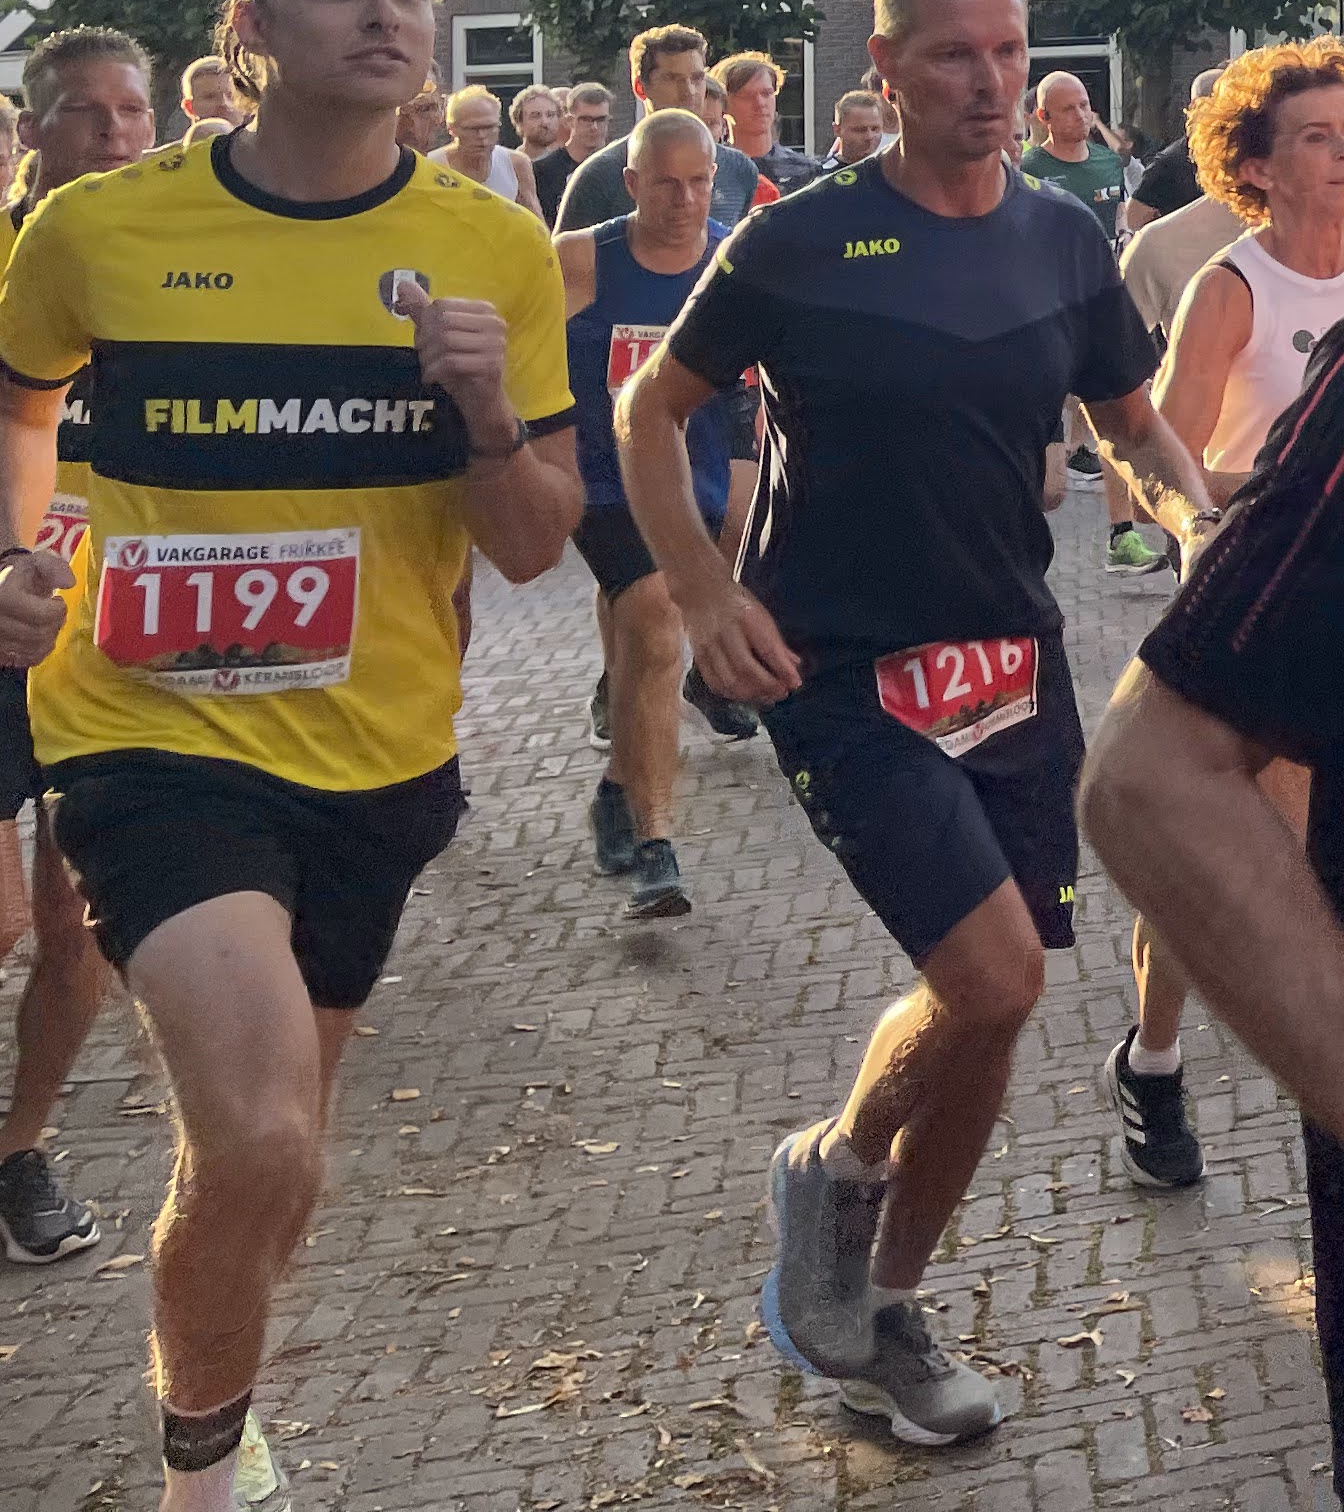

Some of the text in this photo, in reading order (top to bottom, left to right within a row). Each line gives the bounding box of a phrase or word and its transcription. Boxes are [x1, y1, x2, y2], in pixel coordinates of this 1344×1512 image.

[843, 238, 901, 258] JAKO
[161, 271, 234, 289] JAKO
[156, 545, 271, 562] VAKGARAGE
[132, 565, 331, 636] 1199
